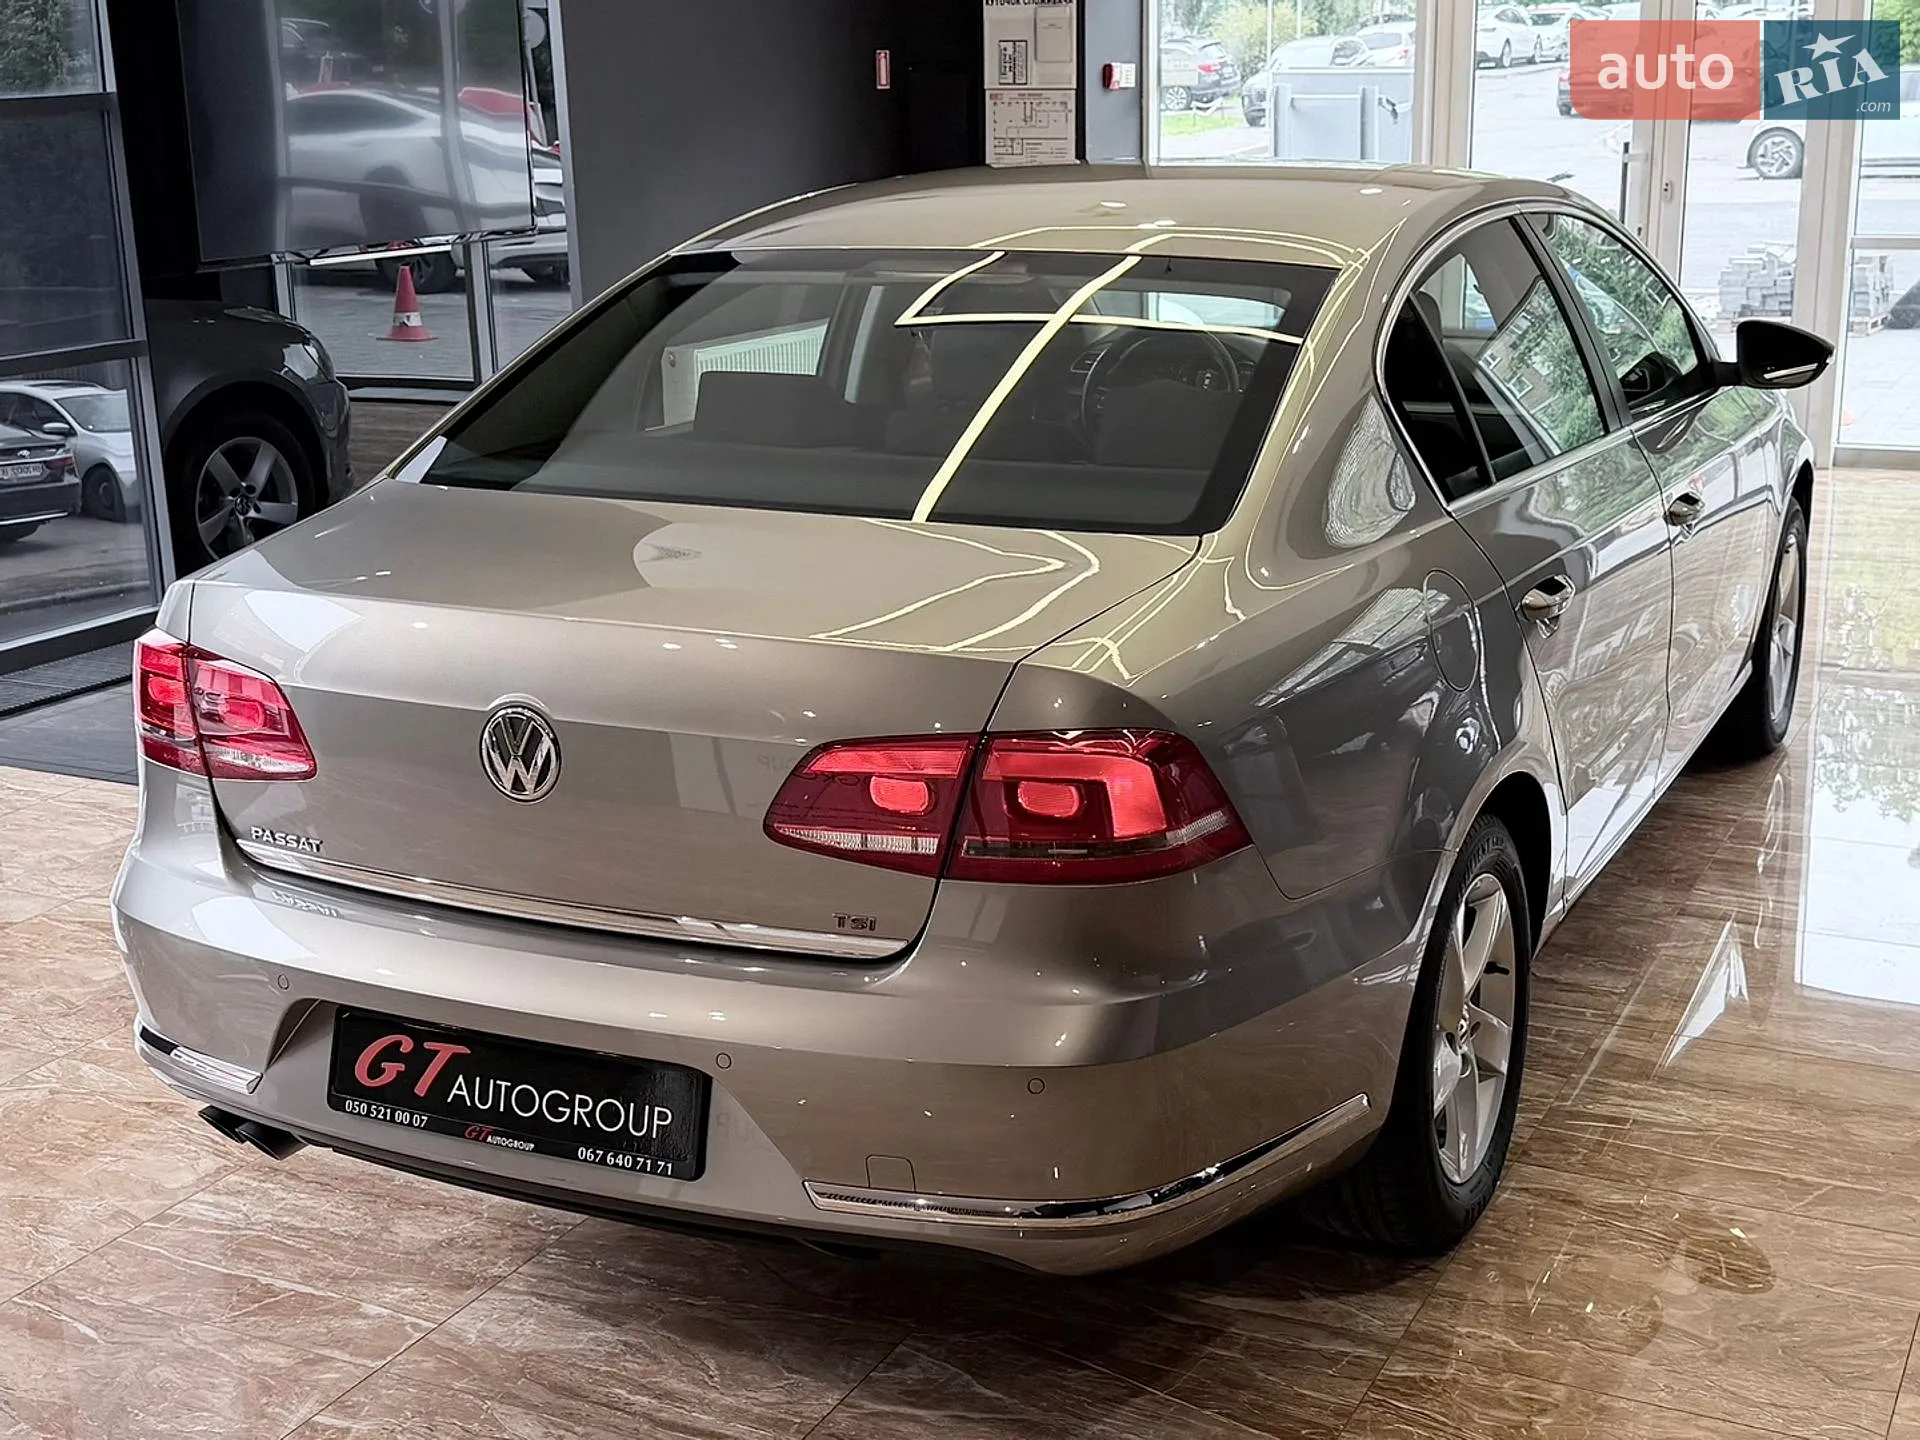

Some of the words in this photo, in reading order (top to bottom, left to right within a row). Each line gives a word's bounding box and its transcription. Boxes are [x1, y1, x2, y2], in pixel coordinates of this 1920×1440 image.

[250, 825, 323, 853] PASSAT
[355, 1035, 471, 1097] GT
[447, 1074, 673, 1139] AUTOGROUP
[345, 1100, 367, 1115] 050
[370, 1105, 391, 1121] 521
[394, 1110, 410, 1125] 00
[412, 1114, 428, 1128] 07
[464, 1125, 493, 1141] GT
[486, 1135, 535, 1151] AUTOGROUP
[577, 1147, 603, 1162] 067
[606, 1152, 632, 1168] 640
[636, 1157, 652, 1172] 71
[657, 1161, 673, 1175] 71
